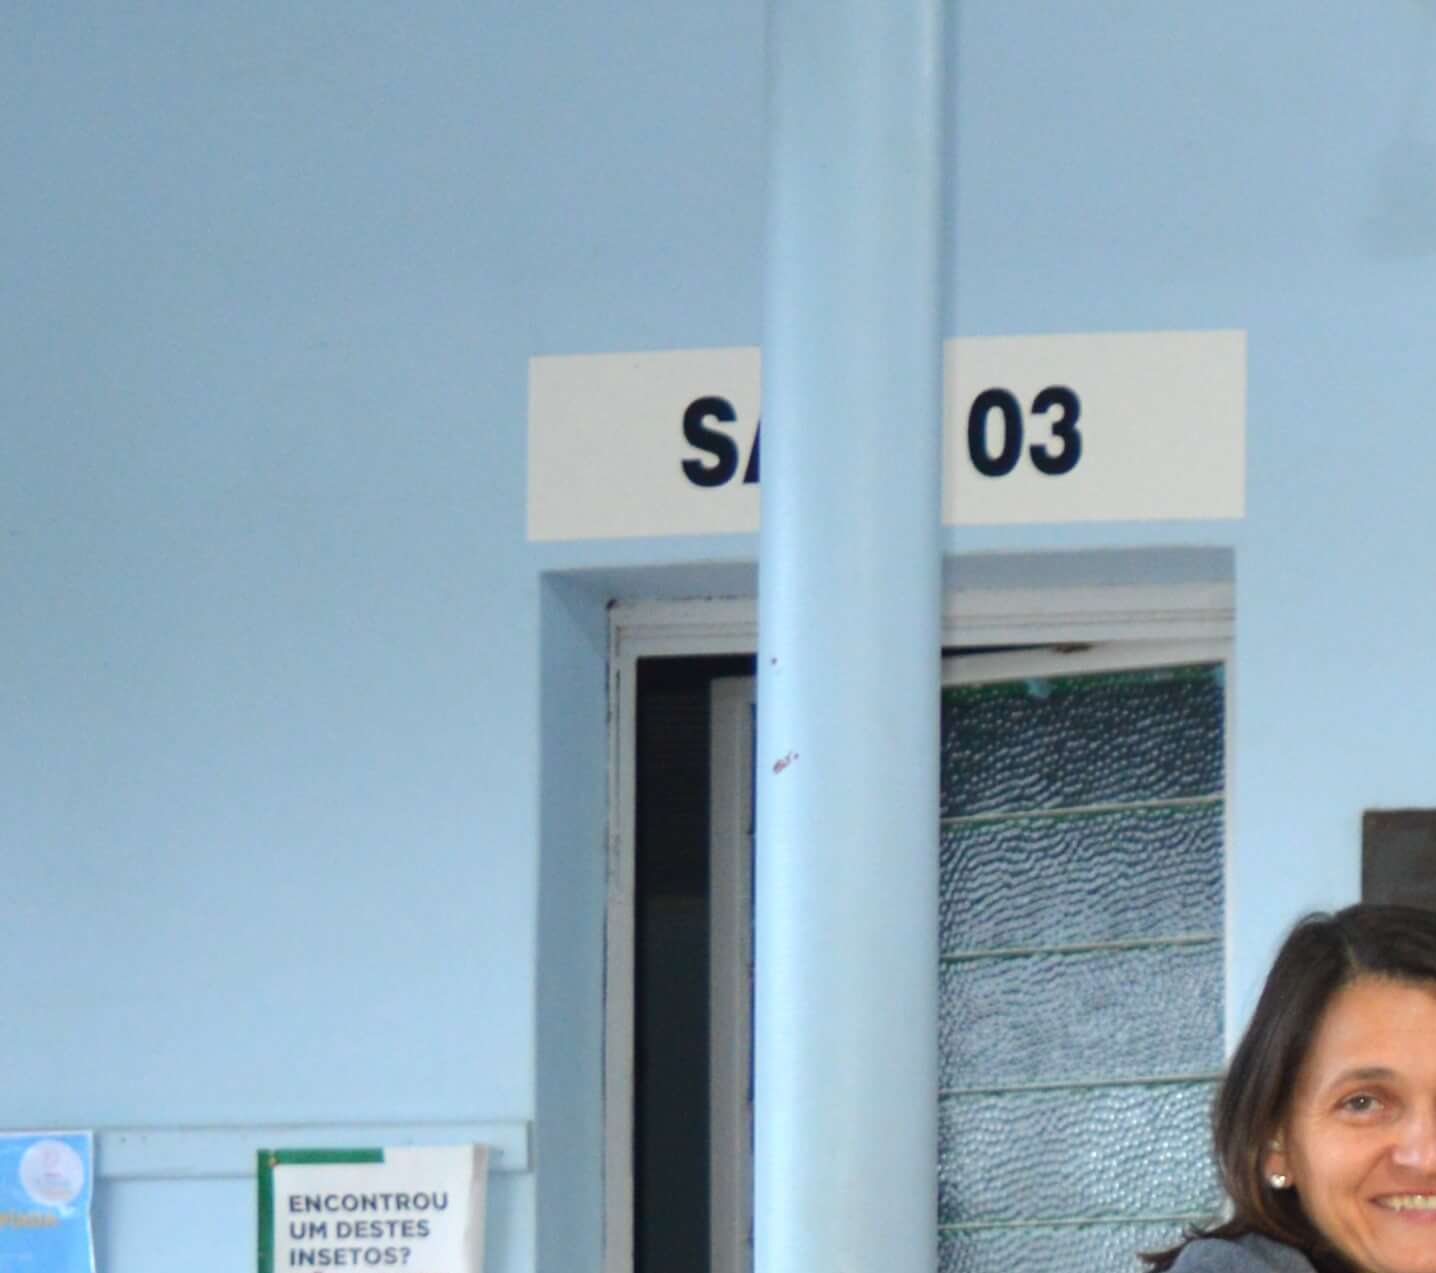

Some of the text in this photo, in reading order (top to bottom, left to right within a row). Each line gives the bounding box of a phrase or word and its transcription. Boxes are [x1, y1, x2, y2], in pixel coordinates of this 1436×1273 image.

[966, 385, 1082, 478] 03
[289, 1192, 448, 1213] ENCONTROU
[289, 1220, 431, 1239] UM DESTES
[289, 1247, 411, 1266] INSETOS?
